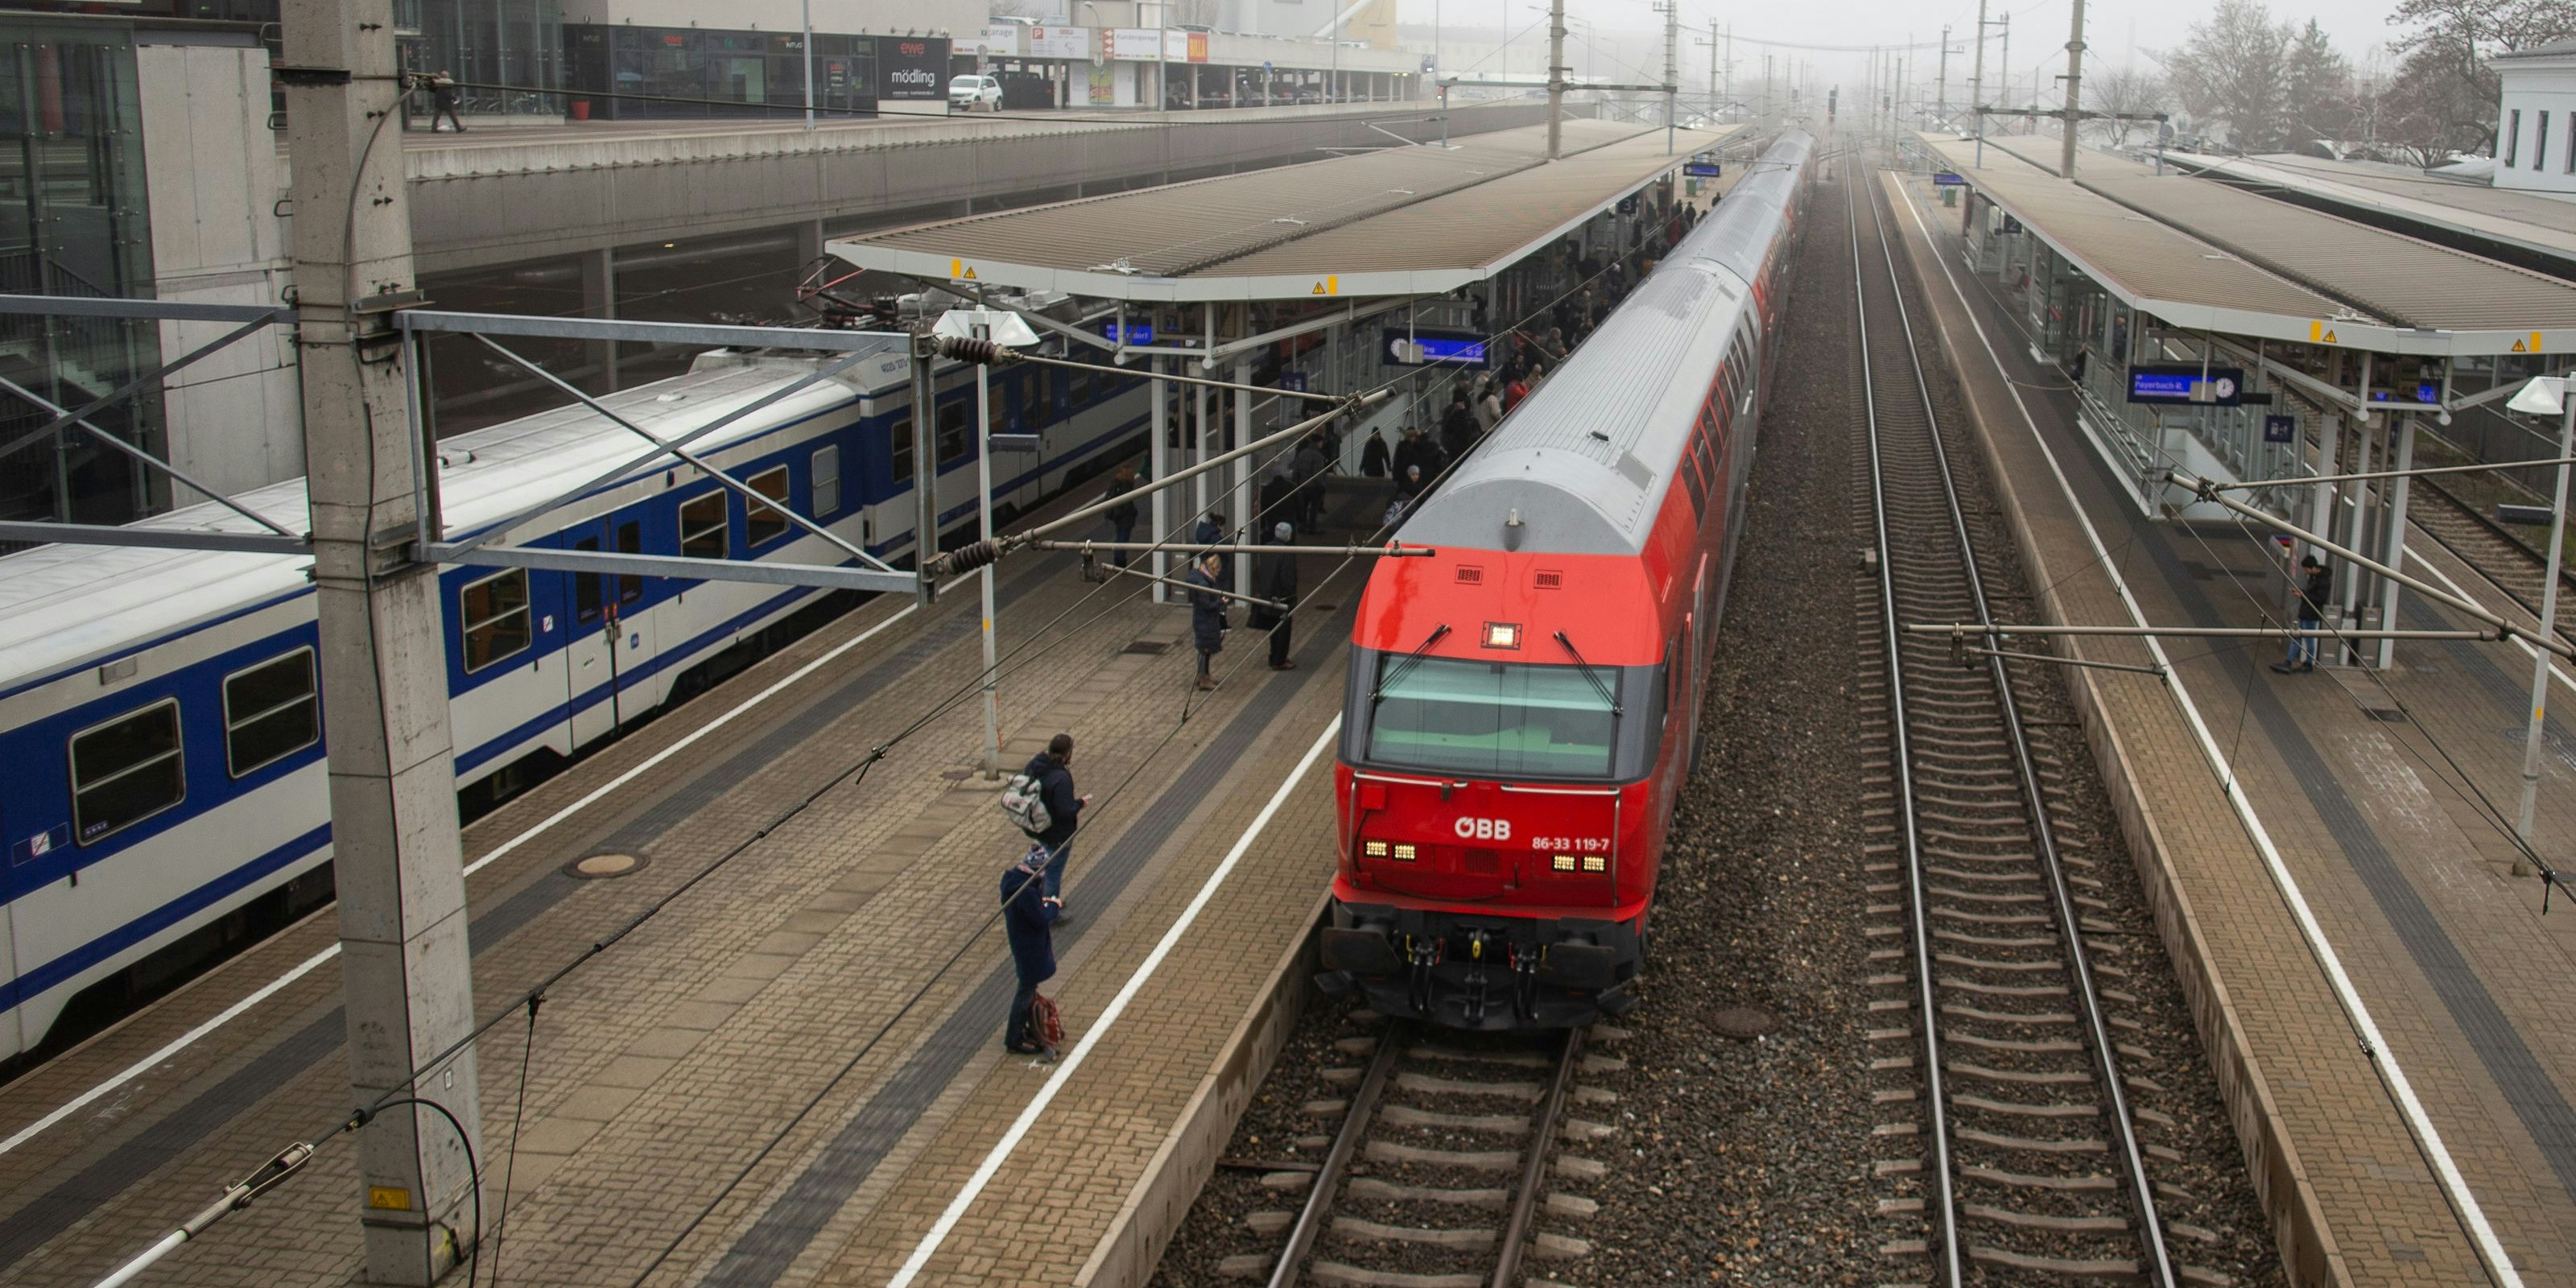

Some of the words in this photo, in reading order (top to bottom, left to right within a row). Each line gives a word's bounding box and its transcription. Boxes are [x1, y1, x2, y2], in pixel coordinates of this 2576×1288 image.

[989, 29, 1013, 38] arage
[1034, 29, 1042, 38] P
[900, 43, 925, 55] ewe
[1189, 38, 1206, 58] BILLA
[891, 68, 935, 87] mödling
[1622, 198, 1632, 211] 3
[2008, 217, 2017, 231] 2
[1454, 816, 1511, 840] ÖBB
[1532, 837, 1570, 850] 86-33
[1575, 838, 1610, 851] 119-7
